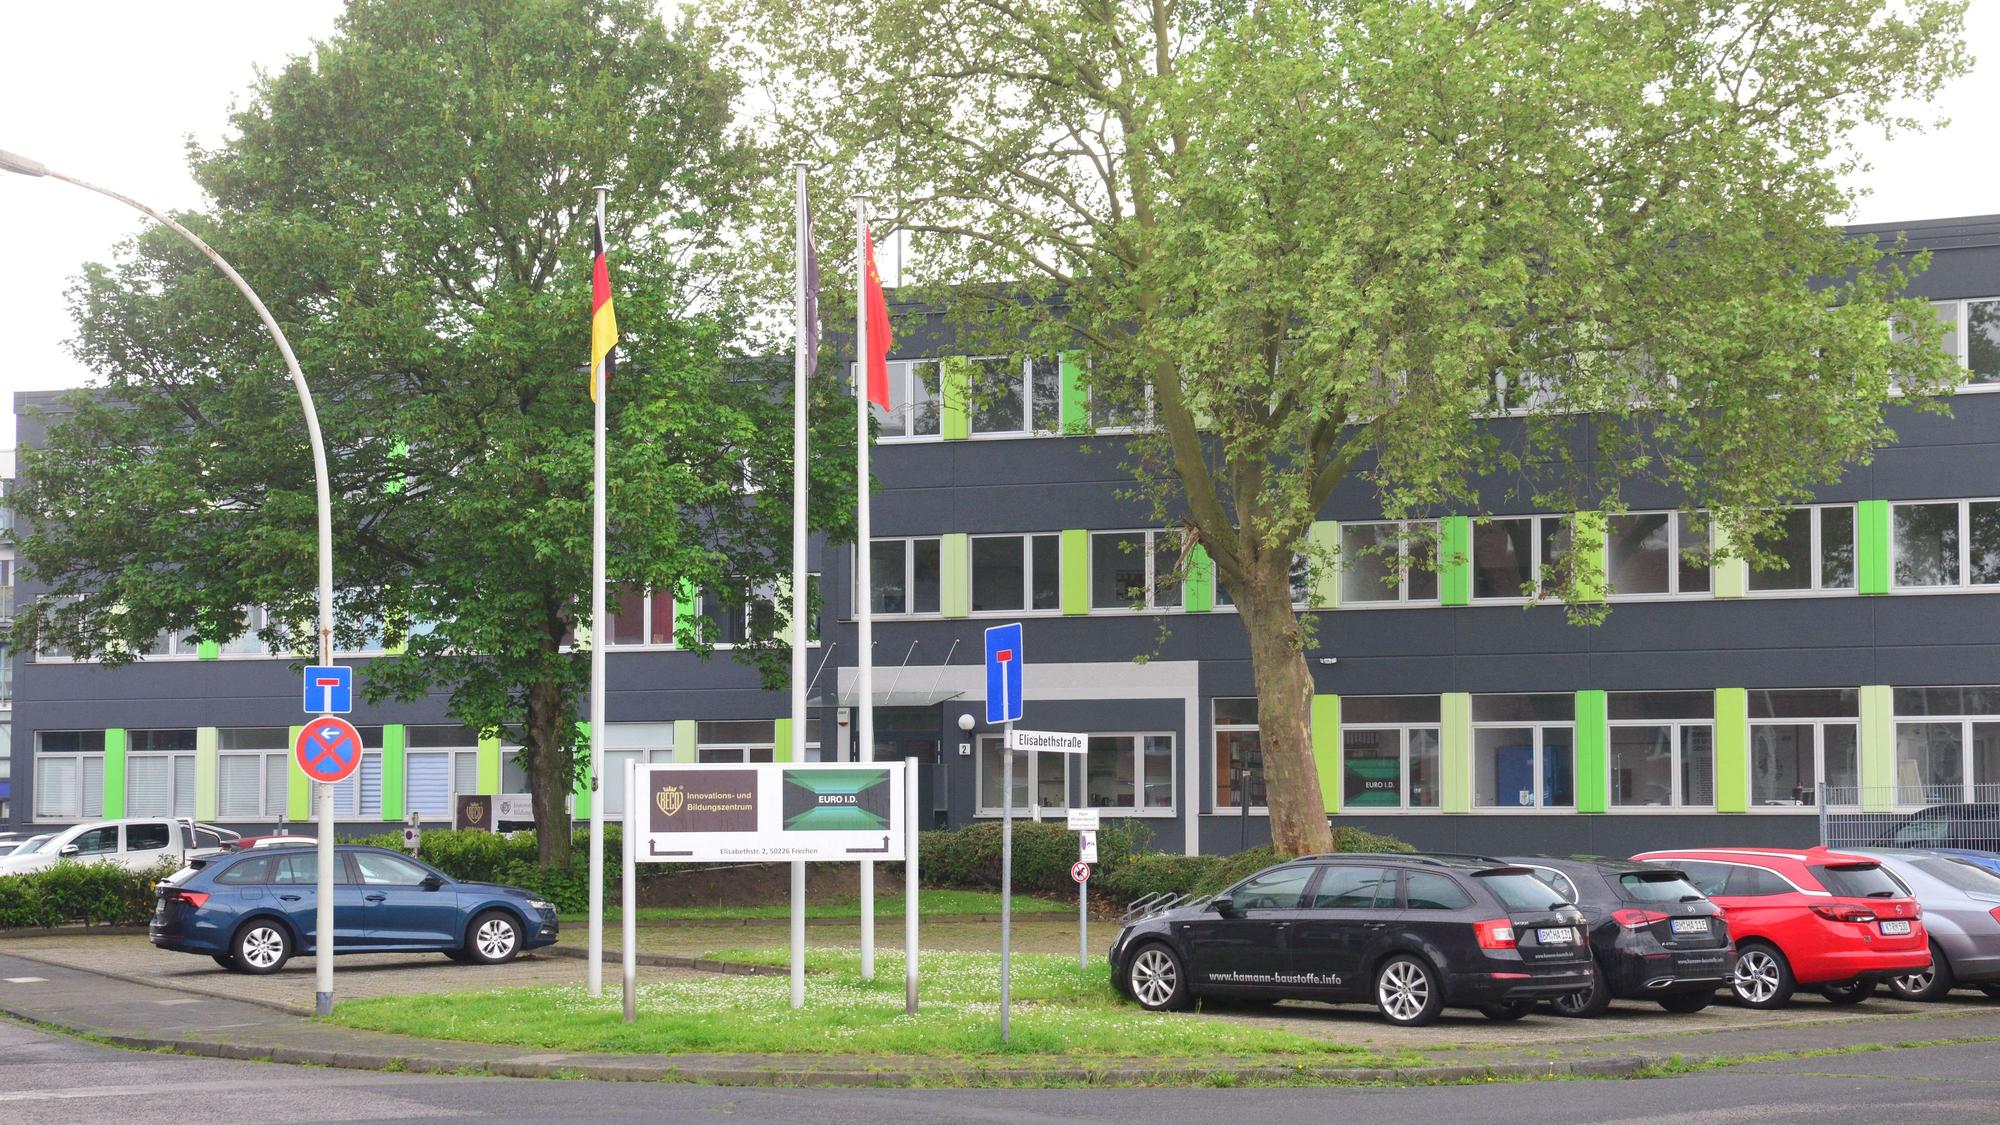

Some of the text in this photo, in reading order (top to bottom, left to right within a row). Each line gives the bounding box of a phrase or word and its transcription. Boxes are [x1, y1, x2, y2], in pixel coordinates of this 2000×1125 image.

[1019, 733, 1082, 748] Elisabethstraße
[962, 745, 967, 753] 2
[687, 792, 734, 800] Innovations-
[818, 795, 858, 803] EURO I.D.
[687, 803, 753, 812] Bildungszentrum
[761, 848, 768, 856] 2,
[769, 847, 790, 855] 50226
[1209, 971, 1342, 985] www.hamann-baustoffe.info
